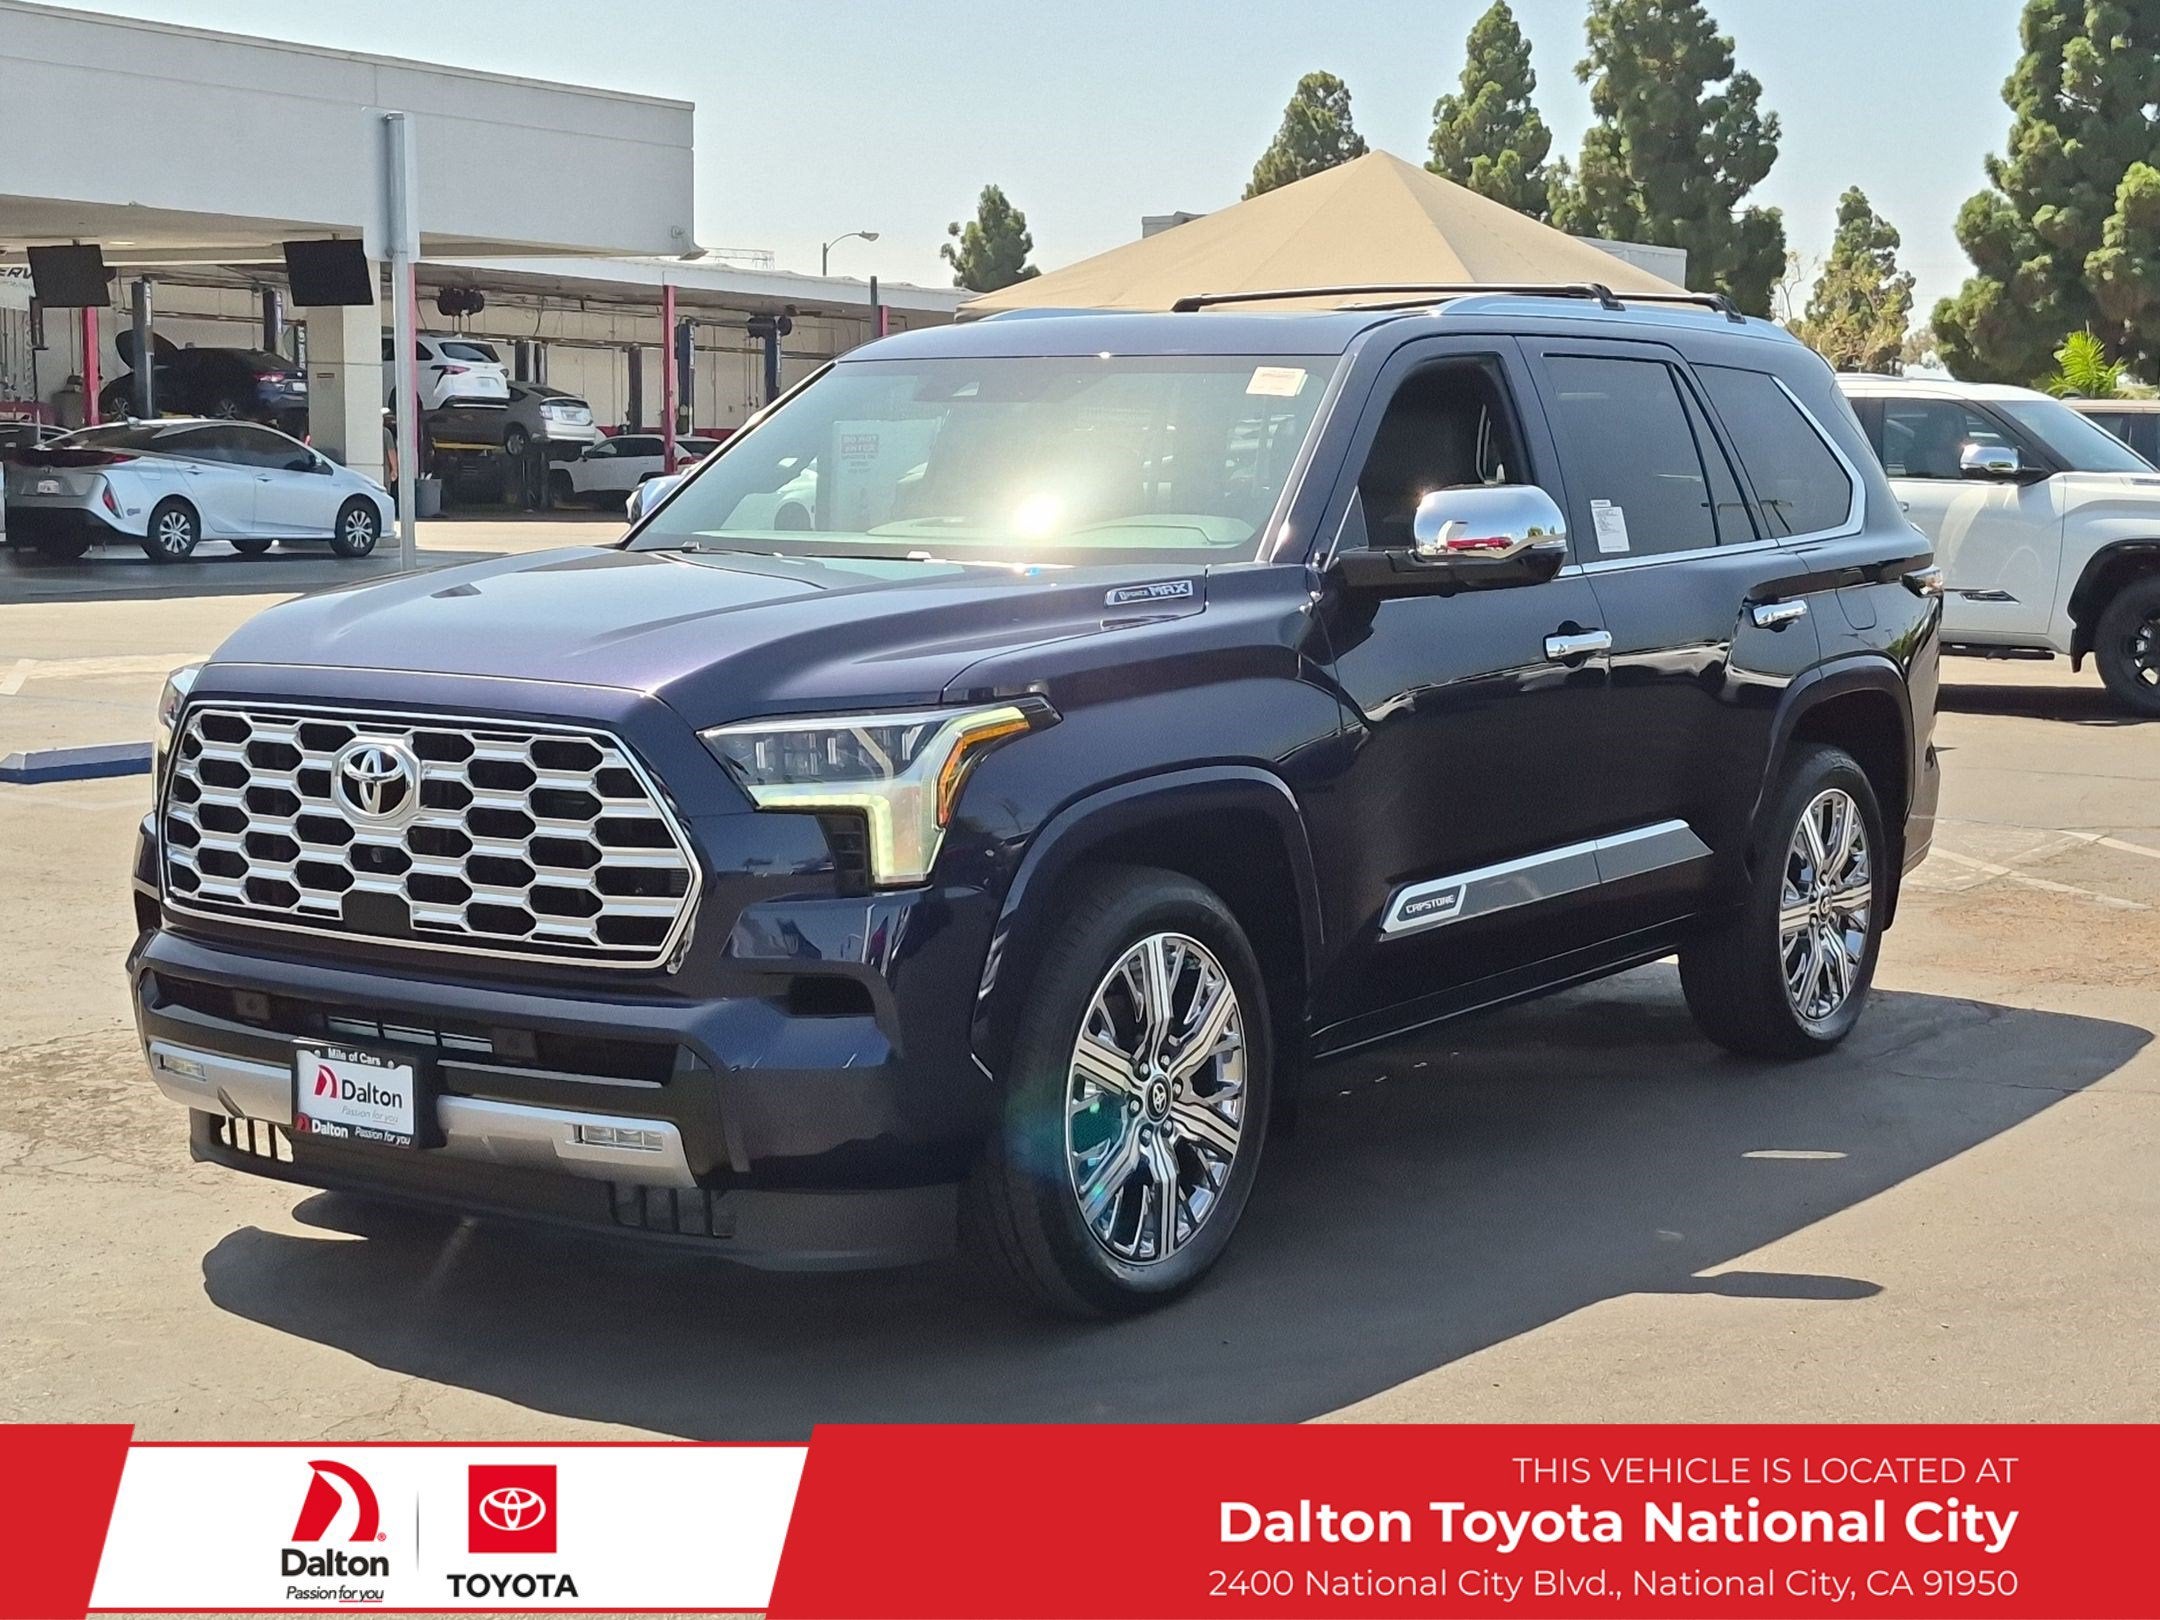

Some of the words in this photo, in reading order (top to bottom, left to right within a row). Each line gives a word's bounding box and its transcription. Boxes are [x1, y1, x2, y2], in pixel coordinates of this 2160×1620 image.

[1148, 584, 1188, 597] MAX
[1405, 894, 1456, 914] CAPSTONE
[327, 1047, 347, 1061] Mile
[348, 1049, 359, 1062] of
[359, 1052, 381, 1066] Cars
[341, 1079, 403, 1108] Dalton
[341, 1105, 371, 1118] Passion
[371, 1108, 385, 1120] for
[311, 1120, 349, 1139] Dalton
[354, 1126, 383, 1141] Passion
[383, 1129, 397, 1143] for
[396, 1134, 411, 1146] you
